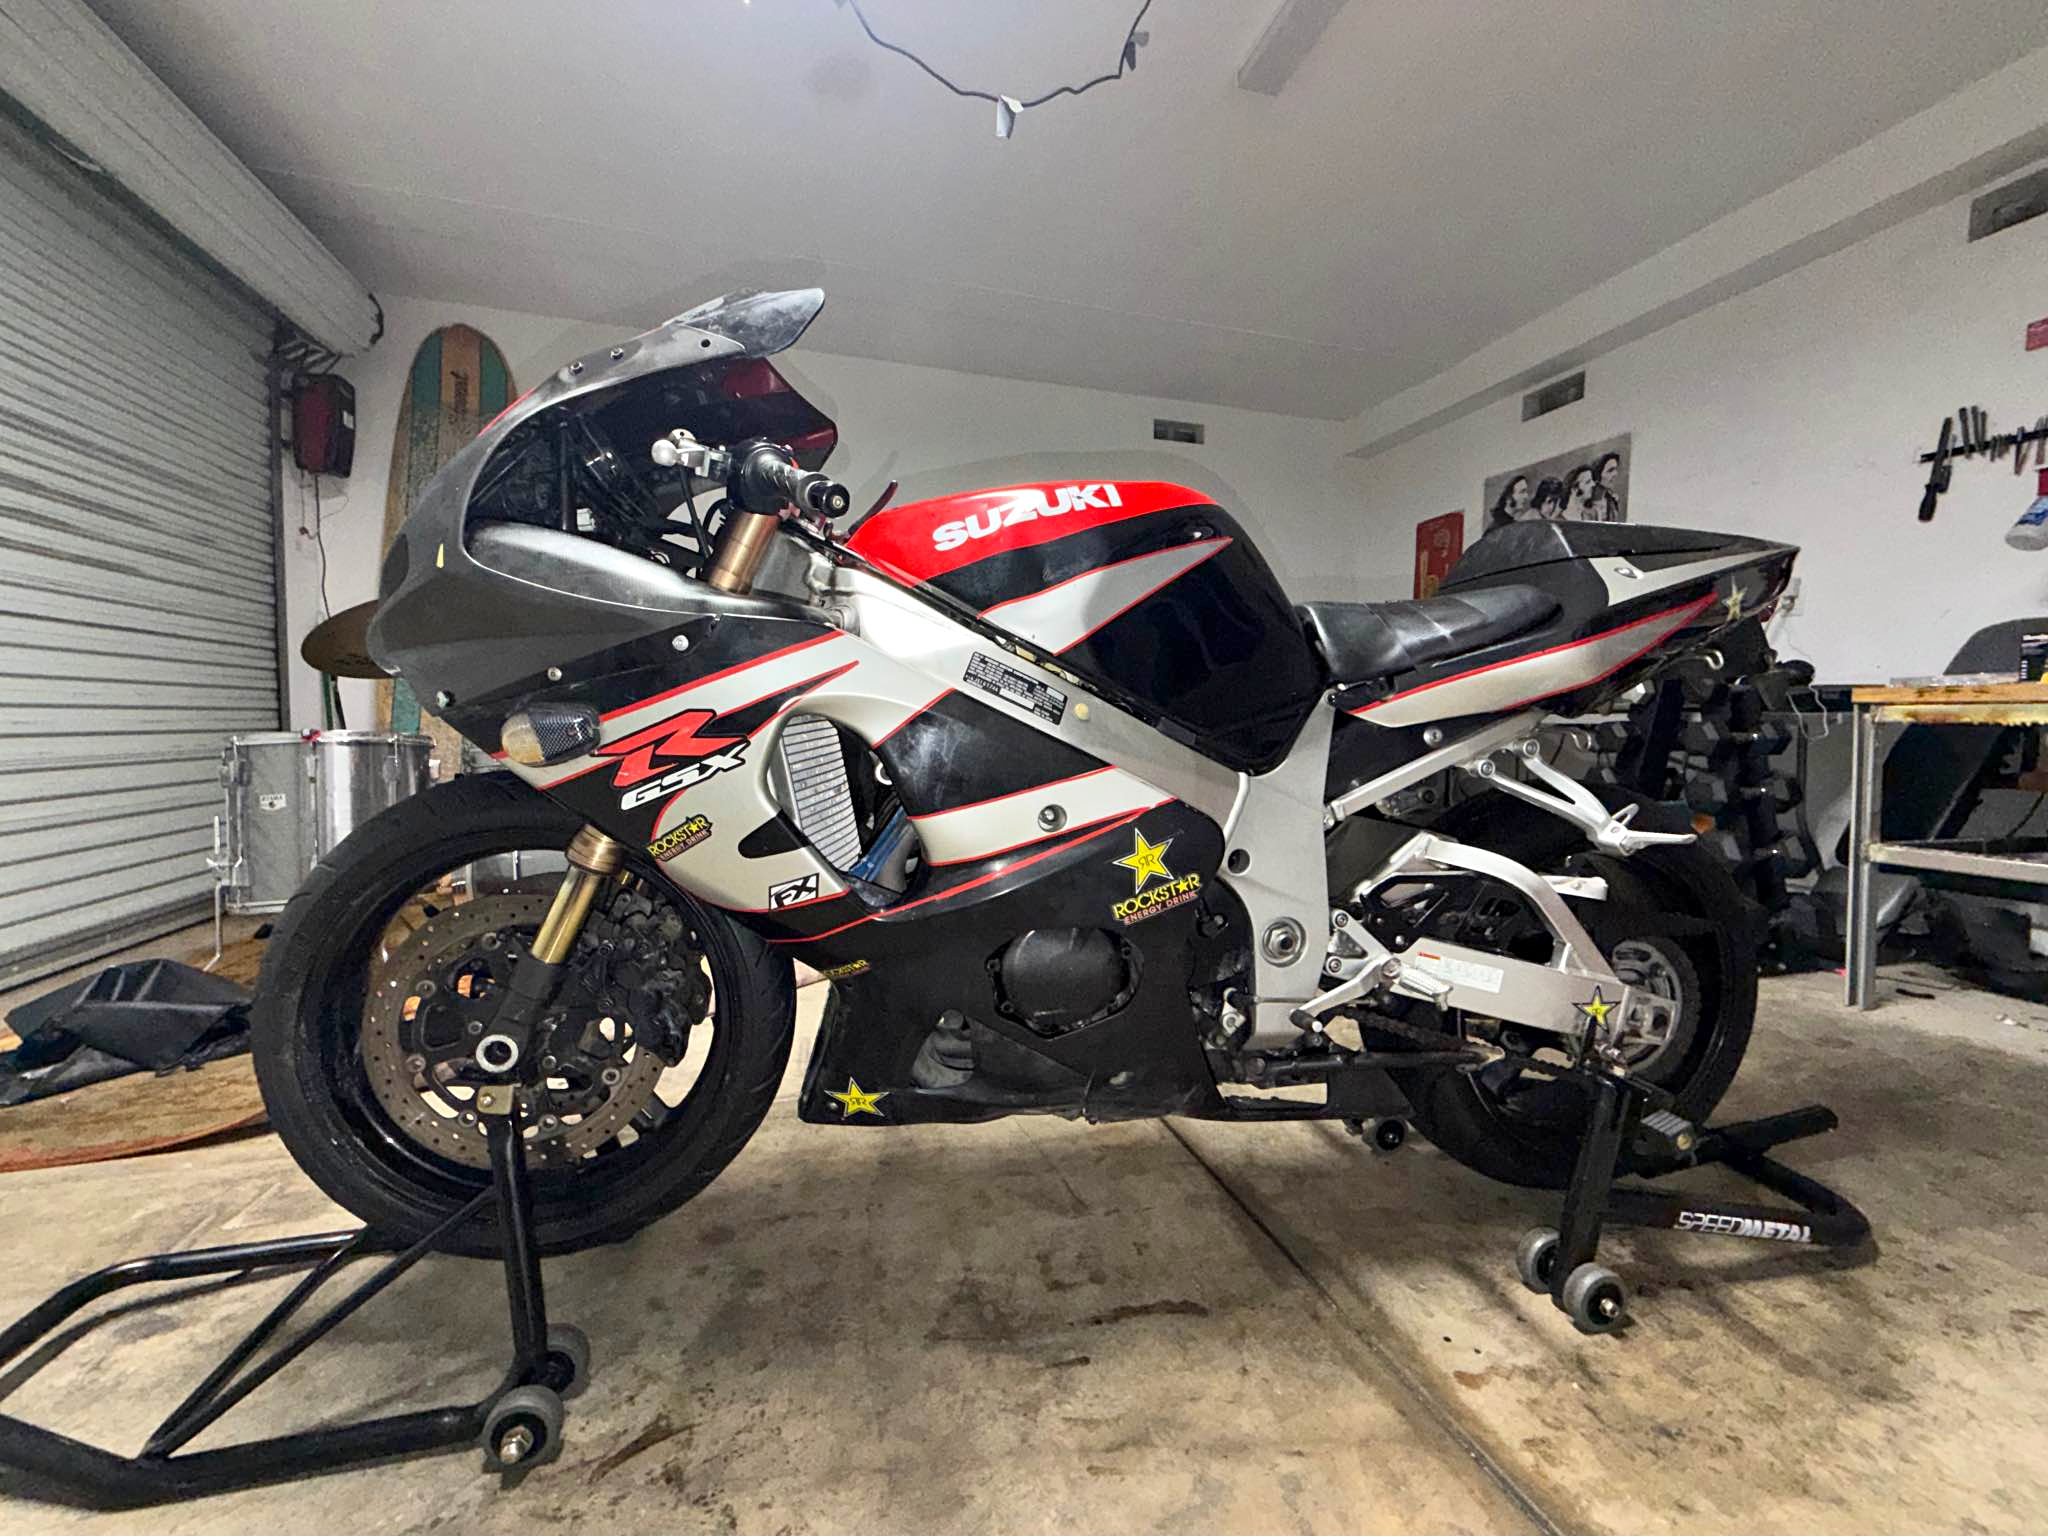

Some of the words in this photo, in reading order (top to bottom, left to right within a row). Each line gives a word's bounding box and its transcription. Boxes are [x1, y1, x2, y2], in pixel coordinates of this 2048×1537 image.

[932, 484, 1123, 551] SUZUKI
[620, 742, 750, 811] GSX
[1124, 902, 1163, 925] ENERGY
[1166, 891, 1196, 907] DRINK
